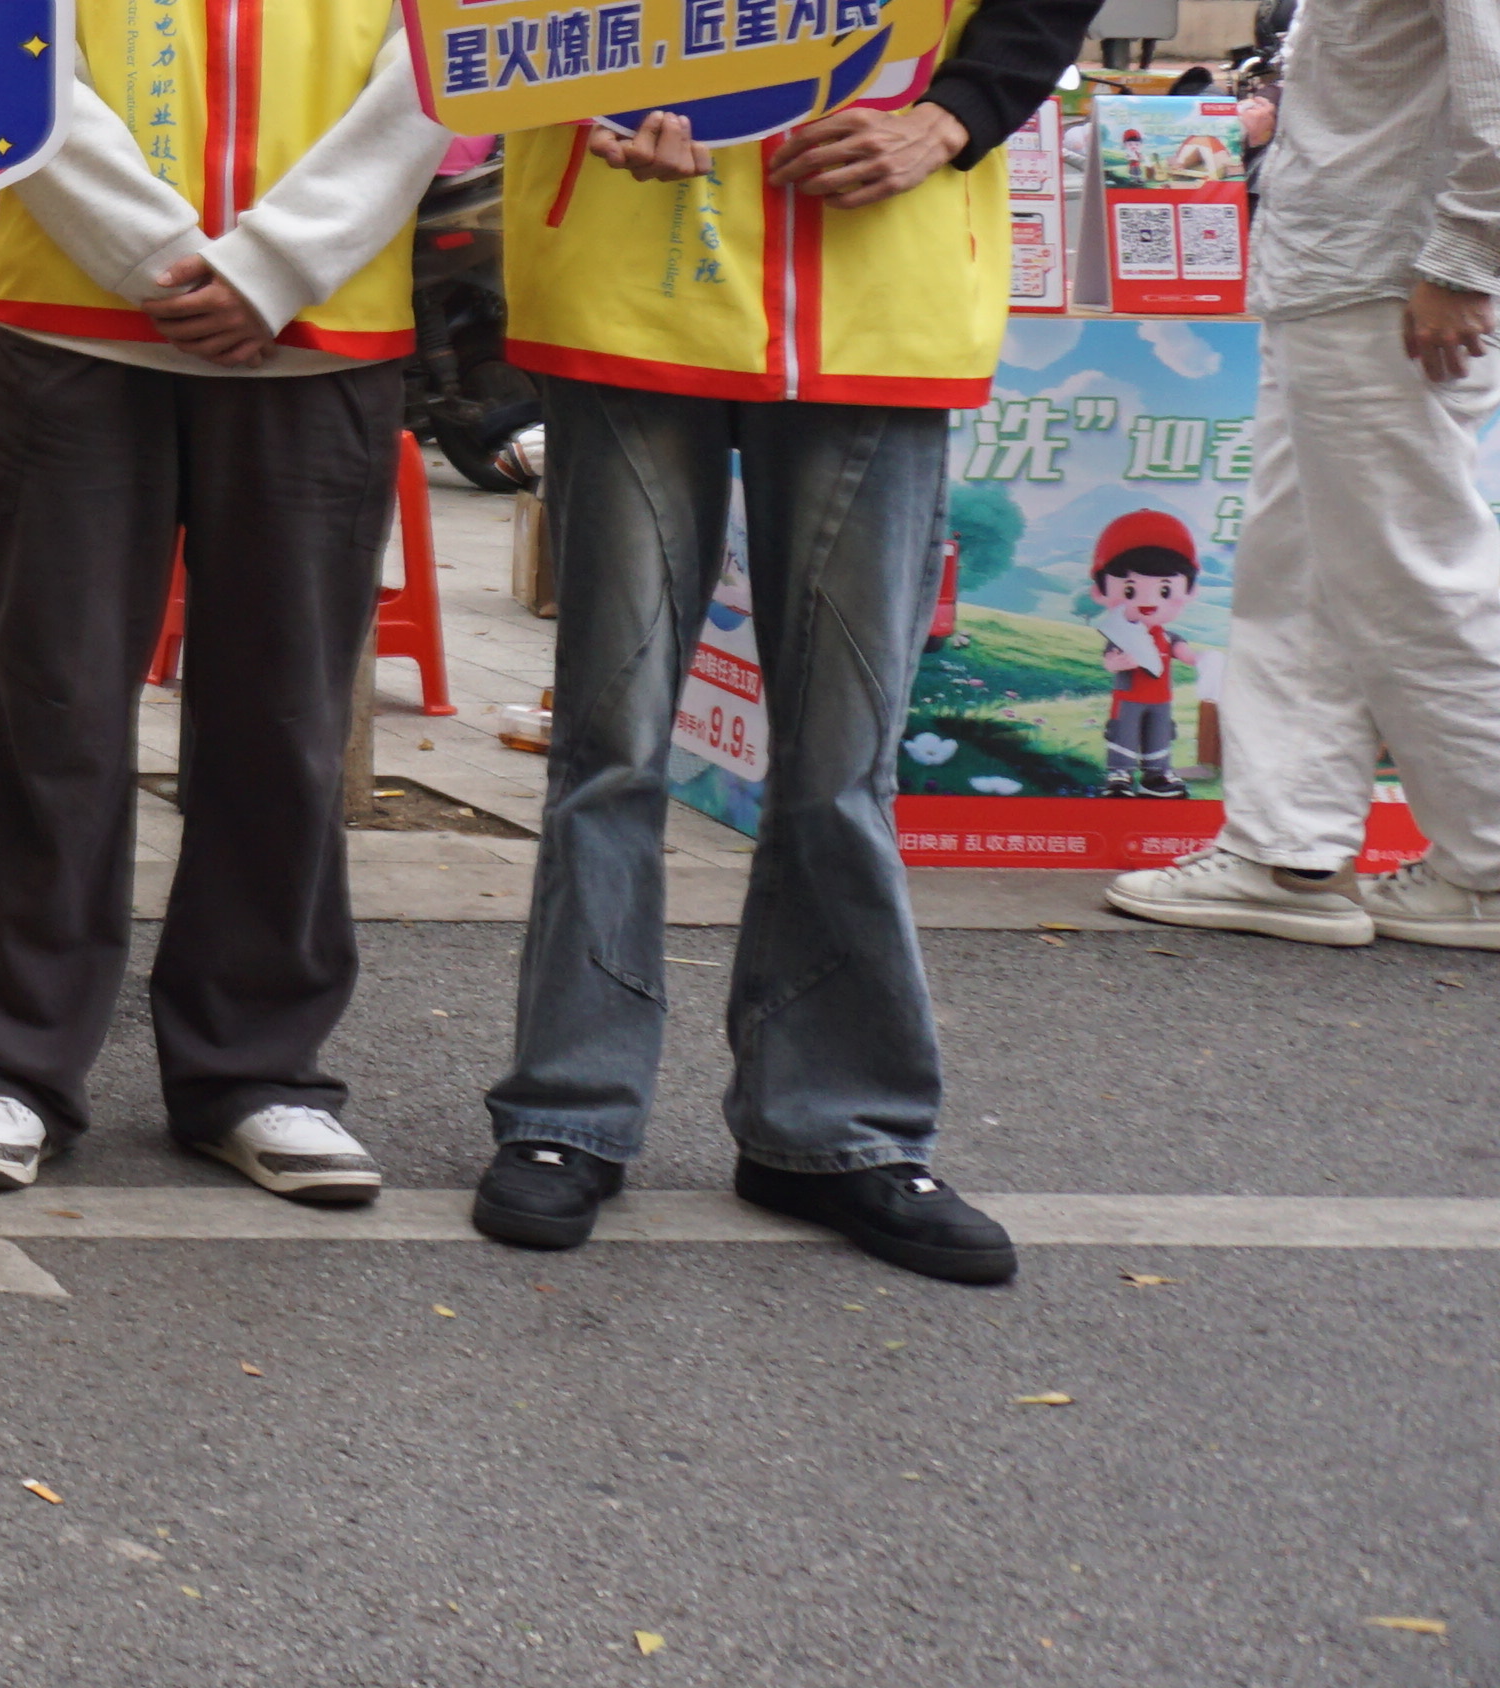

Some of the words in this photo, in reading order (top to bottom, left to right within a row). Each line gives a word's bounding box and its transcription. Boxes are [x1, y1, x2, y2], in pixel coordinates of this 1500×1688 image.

[127, 29, 140, 70] Power
[950, 397, 1253, 482] 洗”迎春
[965, 834, 1087, 854] 乱收费双倍赔
